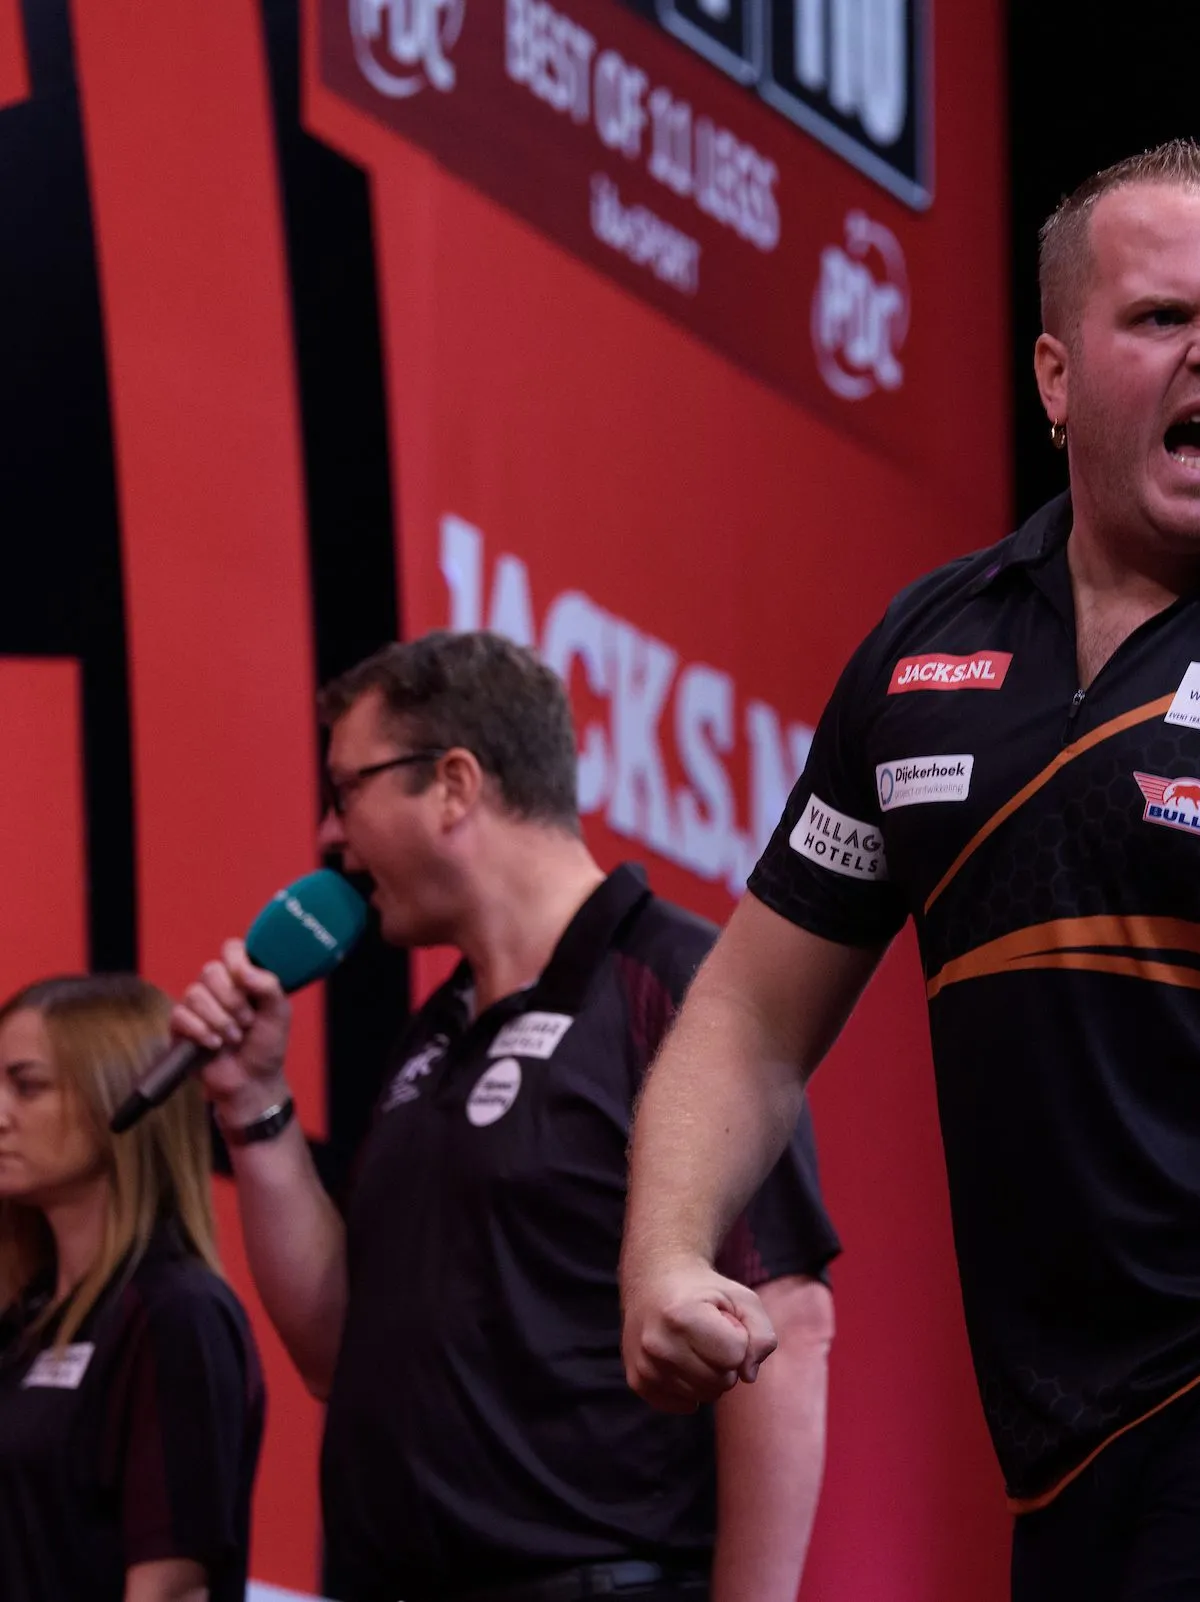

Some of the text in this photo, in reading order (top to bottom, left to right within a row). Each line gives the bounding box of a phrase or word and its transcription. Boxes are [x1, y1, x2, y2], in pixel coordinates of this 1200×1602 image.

[505, 0, 596, 123] BEST
[594, 49, 647, 158] OF
[898, 660, 996, 685] JACKS.NL
[1169, 711, 1188, 721] EVENT
[895, 762, 965, 784] Dijckerhoek
[810, 805, 881, 852] VILLAG
[804, 832, 879, 873] HOTELS
